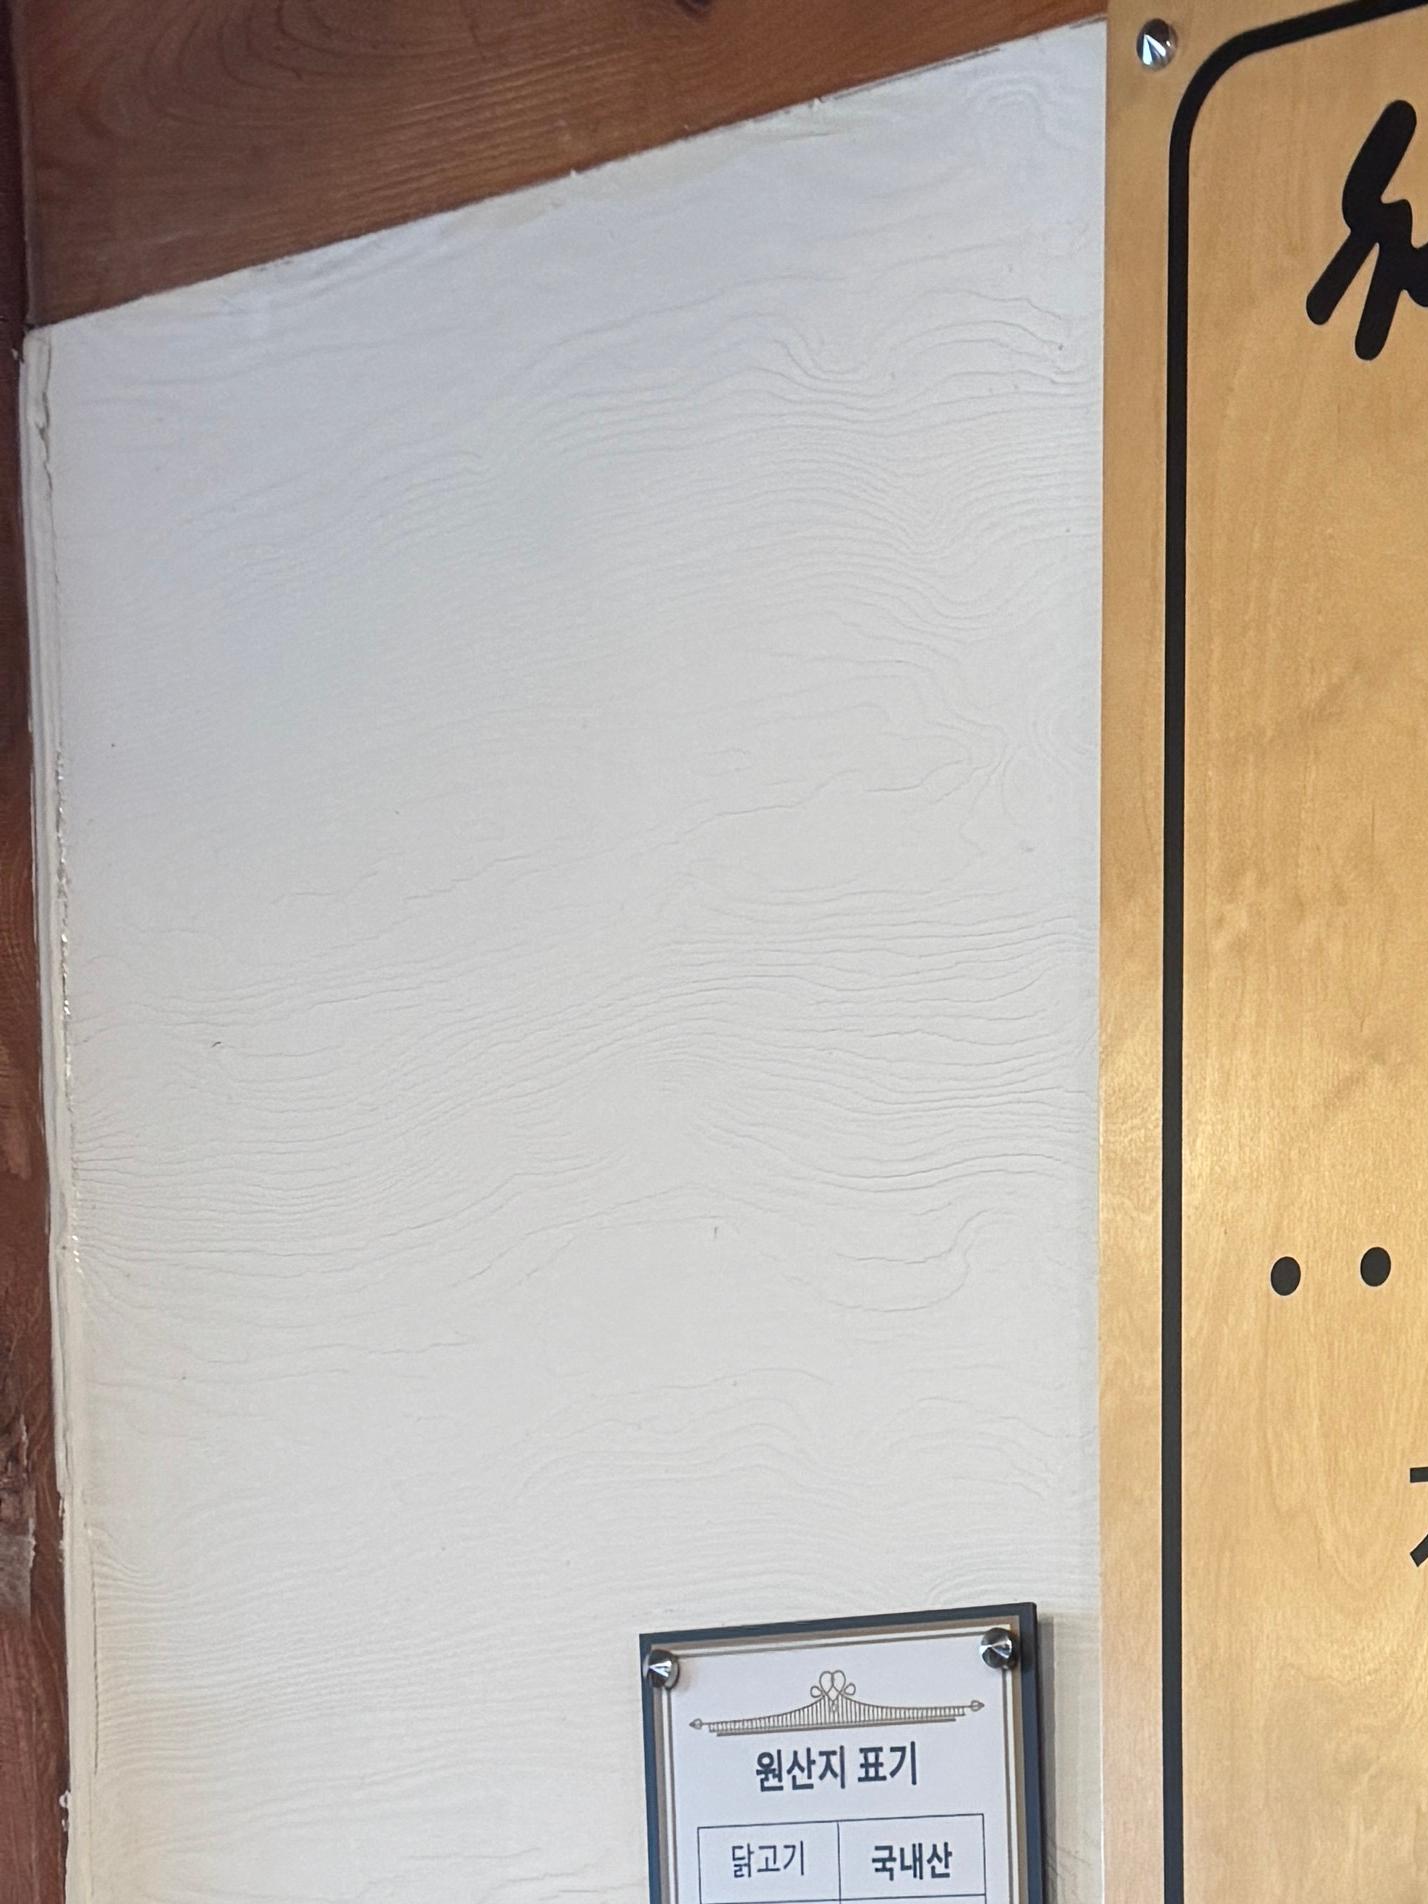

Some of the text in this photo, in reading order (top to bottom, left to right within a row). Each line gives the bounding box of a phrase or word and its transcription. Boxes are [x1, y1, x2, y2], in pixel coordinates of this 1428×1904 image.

[756, 1741, 916, 1792] 원산지 표기
[732, 1841, 952, 1881] 닭고기 국내산
